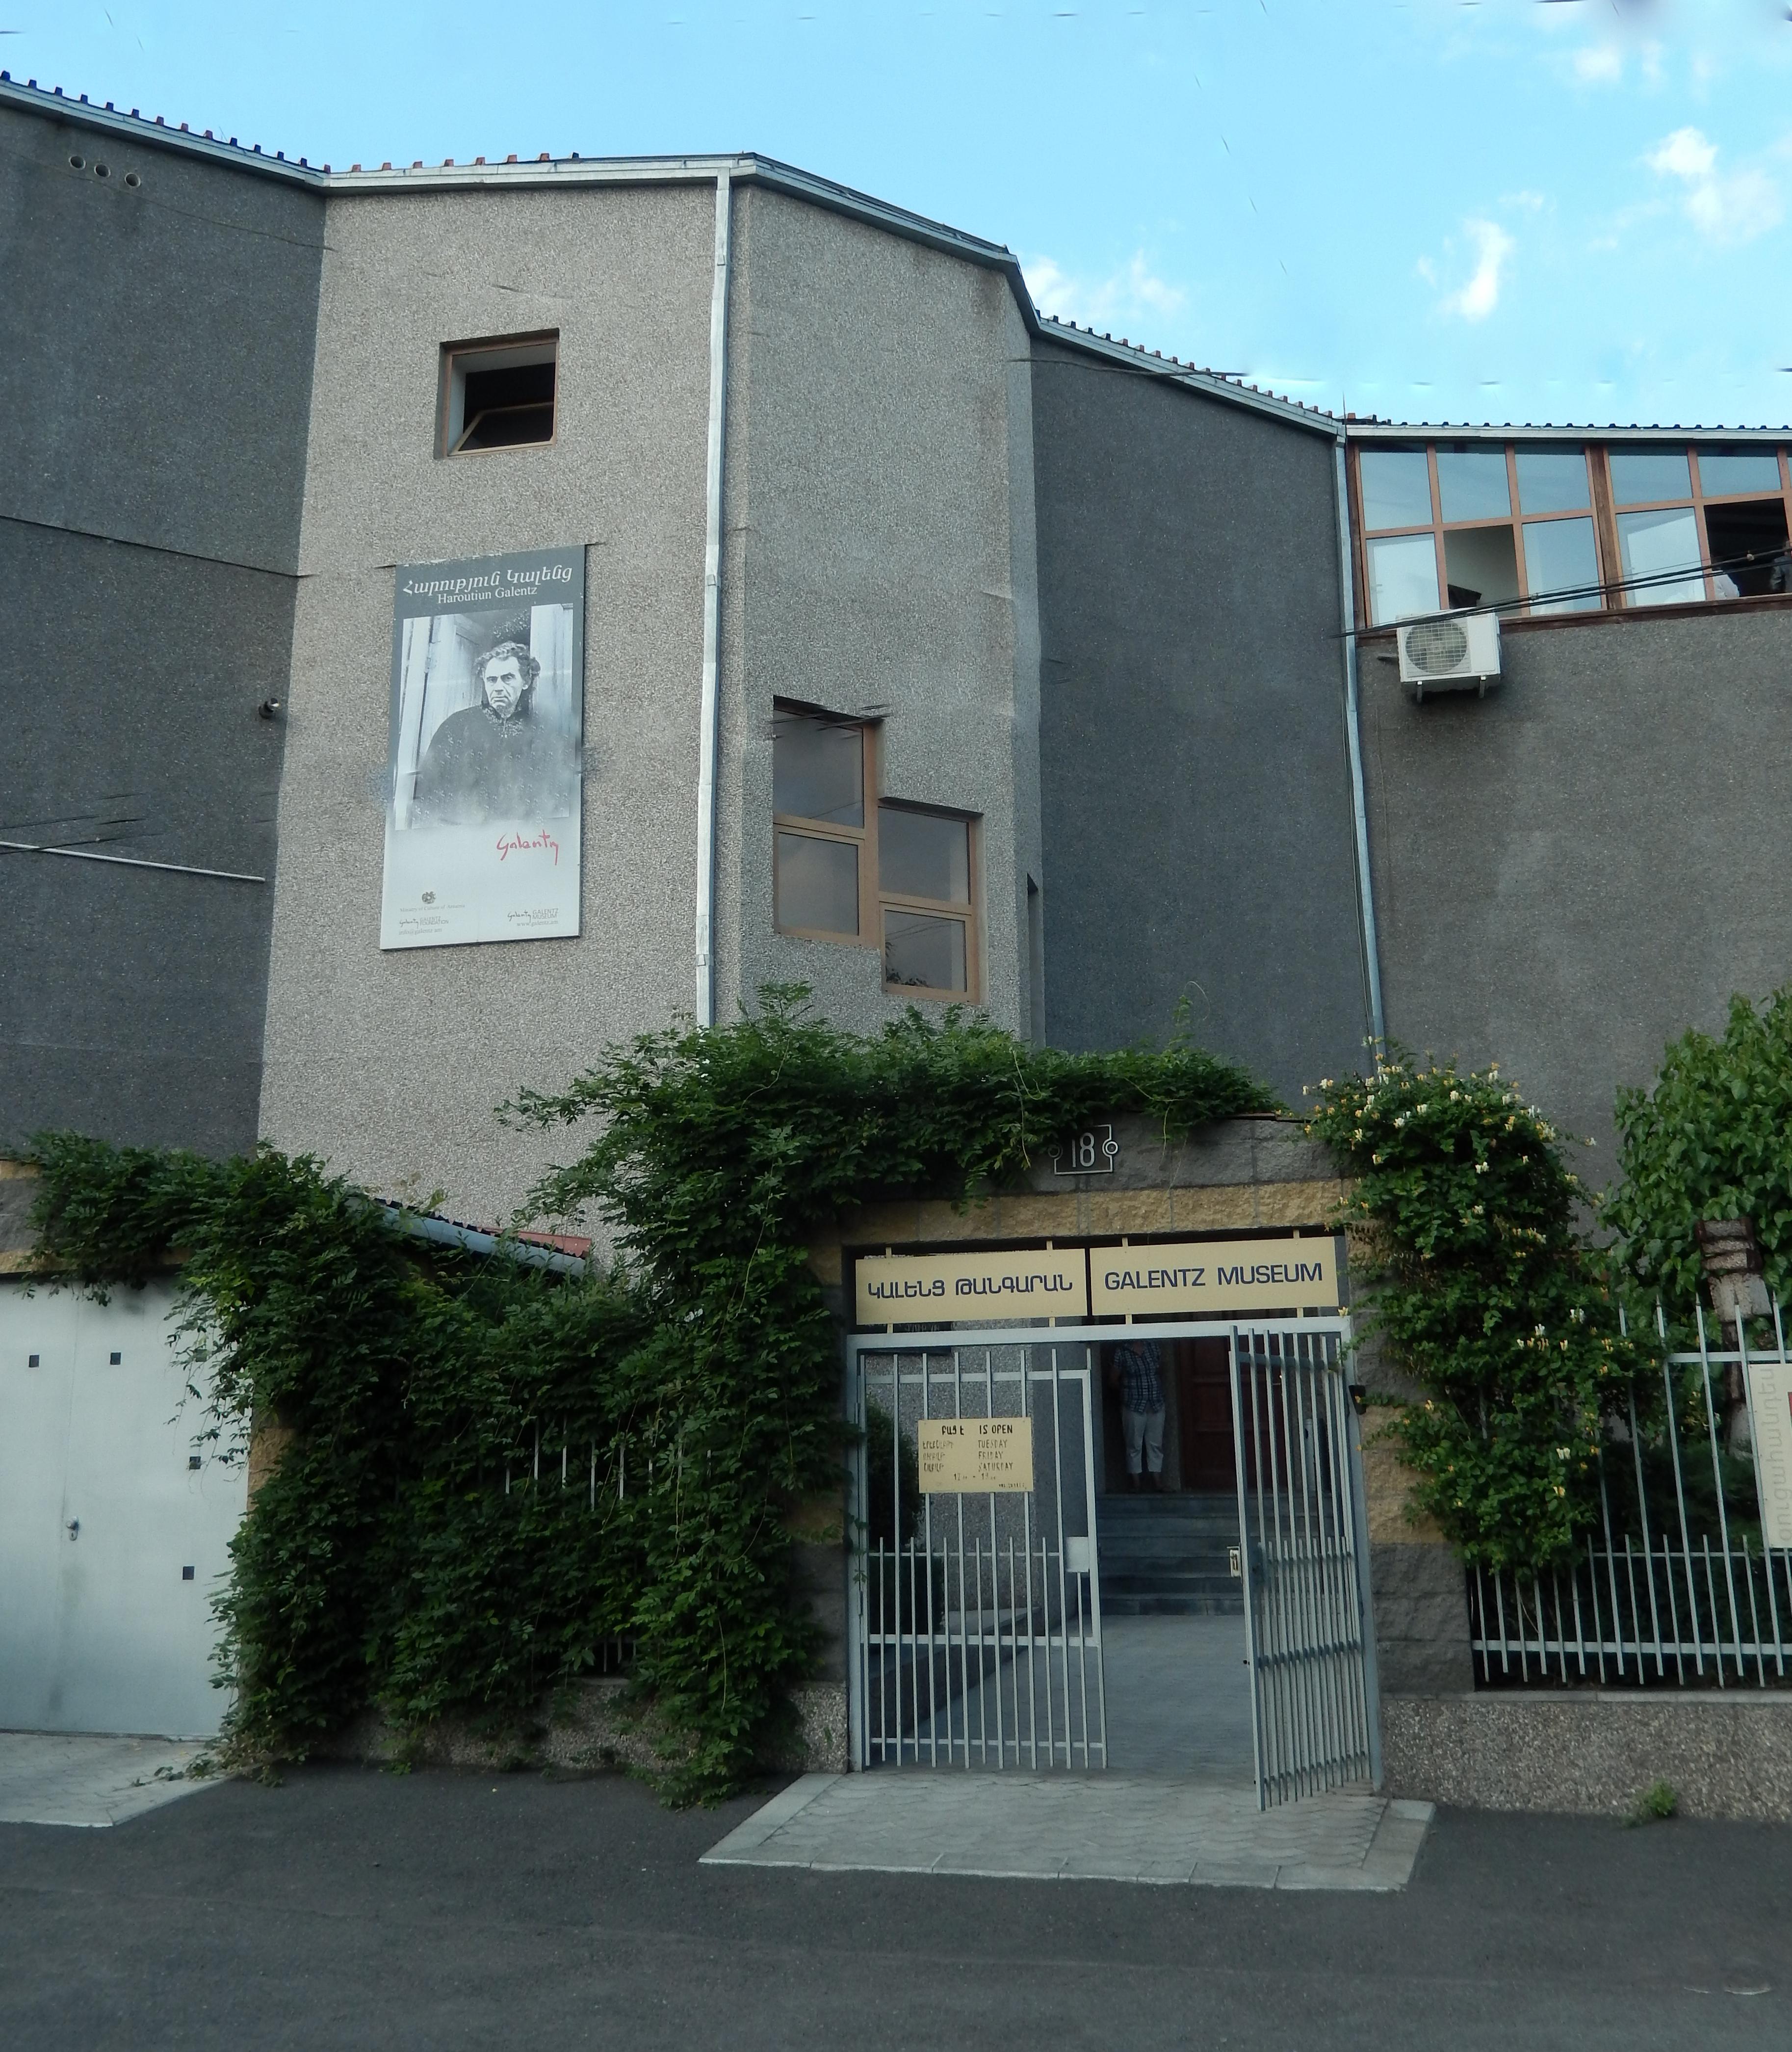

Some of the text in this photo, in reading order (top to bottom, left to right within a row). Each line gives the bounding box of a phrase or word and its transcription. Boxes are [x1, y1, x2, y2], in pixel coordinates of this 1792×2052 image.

[403, 565, 573, 596] Հարություն Կալենց
[438, 586, 538, 604] Haroutiun Galentz
[1072, 1132, 1095, 1167] 18
[1105, 1263, 1323, 1290] GALENTZ MUSEUM
[868, 1274, 1073, 1299] ԿԱԼԵՆՑ ԹԱՆԳԱՐԱՆ
[980, 1424, 1013, 1434] IS OPEN
[978, 1439, 1008, 1448] TUESDAY
[978, 1451, 1004, 1460] FRIDAY
[978, 1462, 1013, 1472] SATURDAY
